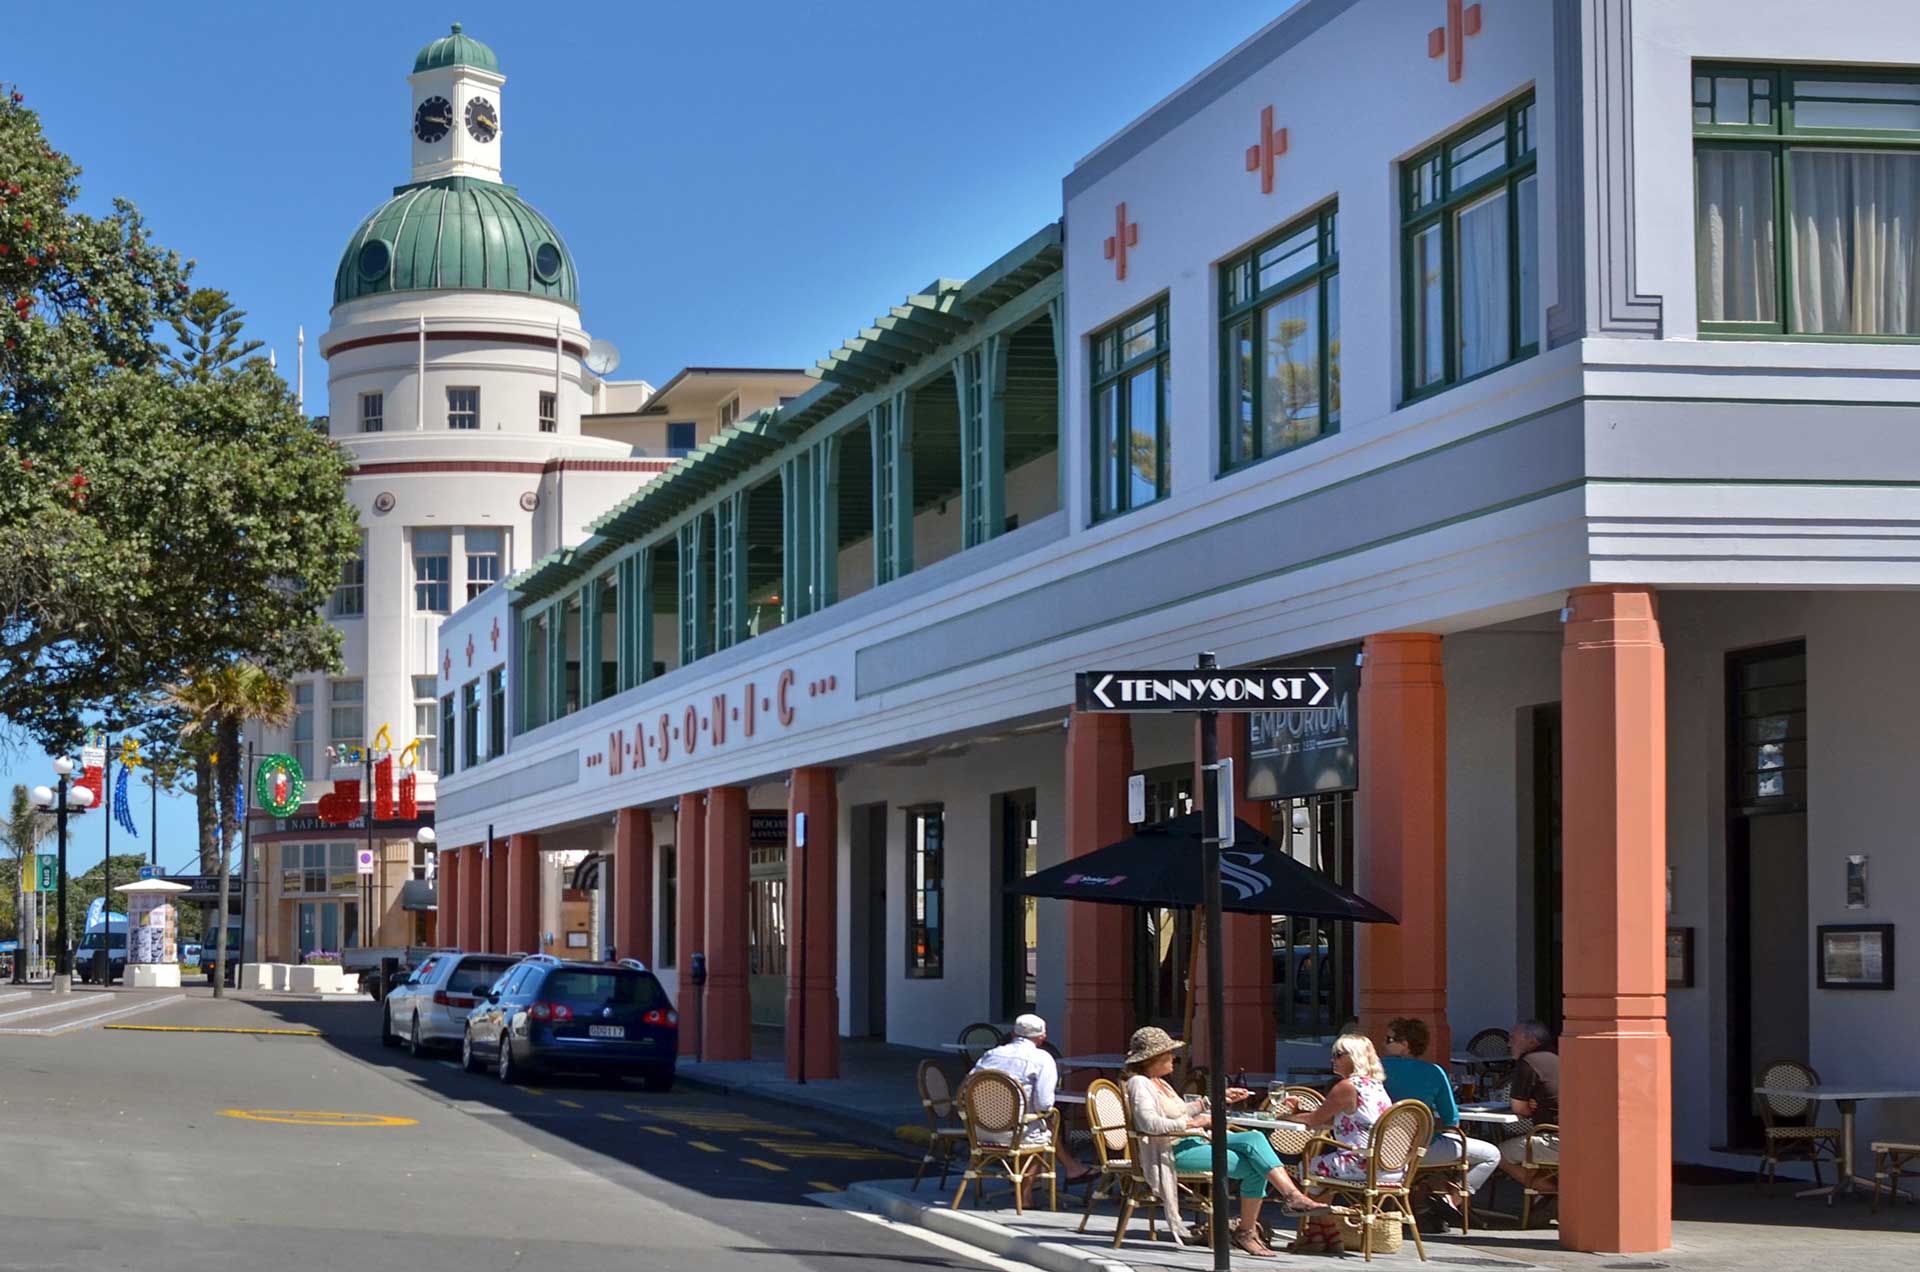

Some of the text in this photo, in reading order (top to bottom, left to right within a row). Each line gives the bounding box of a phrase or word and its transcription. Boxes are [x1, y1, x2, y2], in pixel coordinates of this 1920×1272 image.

[1117, 677, 1306, 702] TENNYSON ST
[1250, 690, 1348, 745] EMPORIUM
